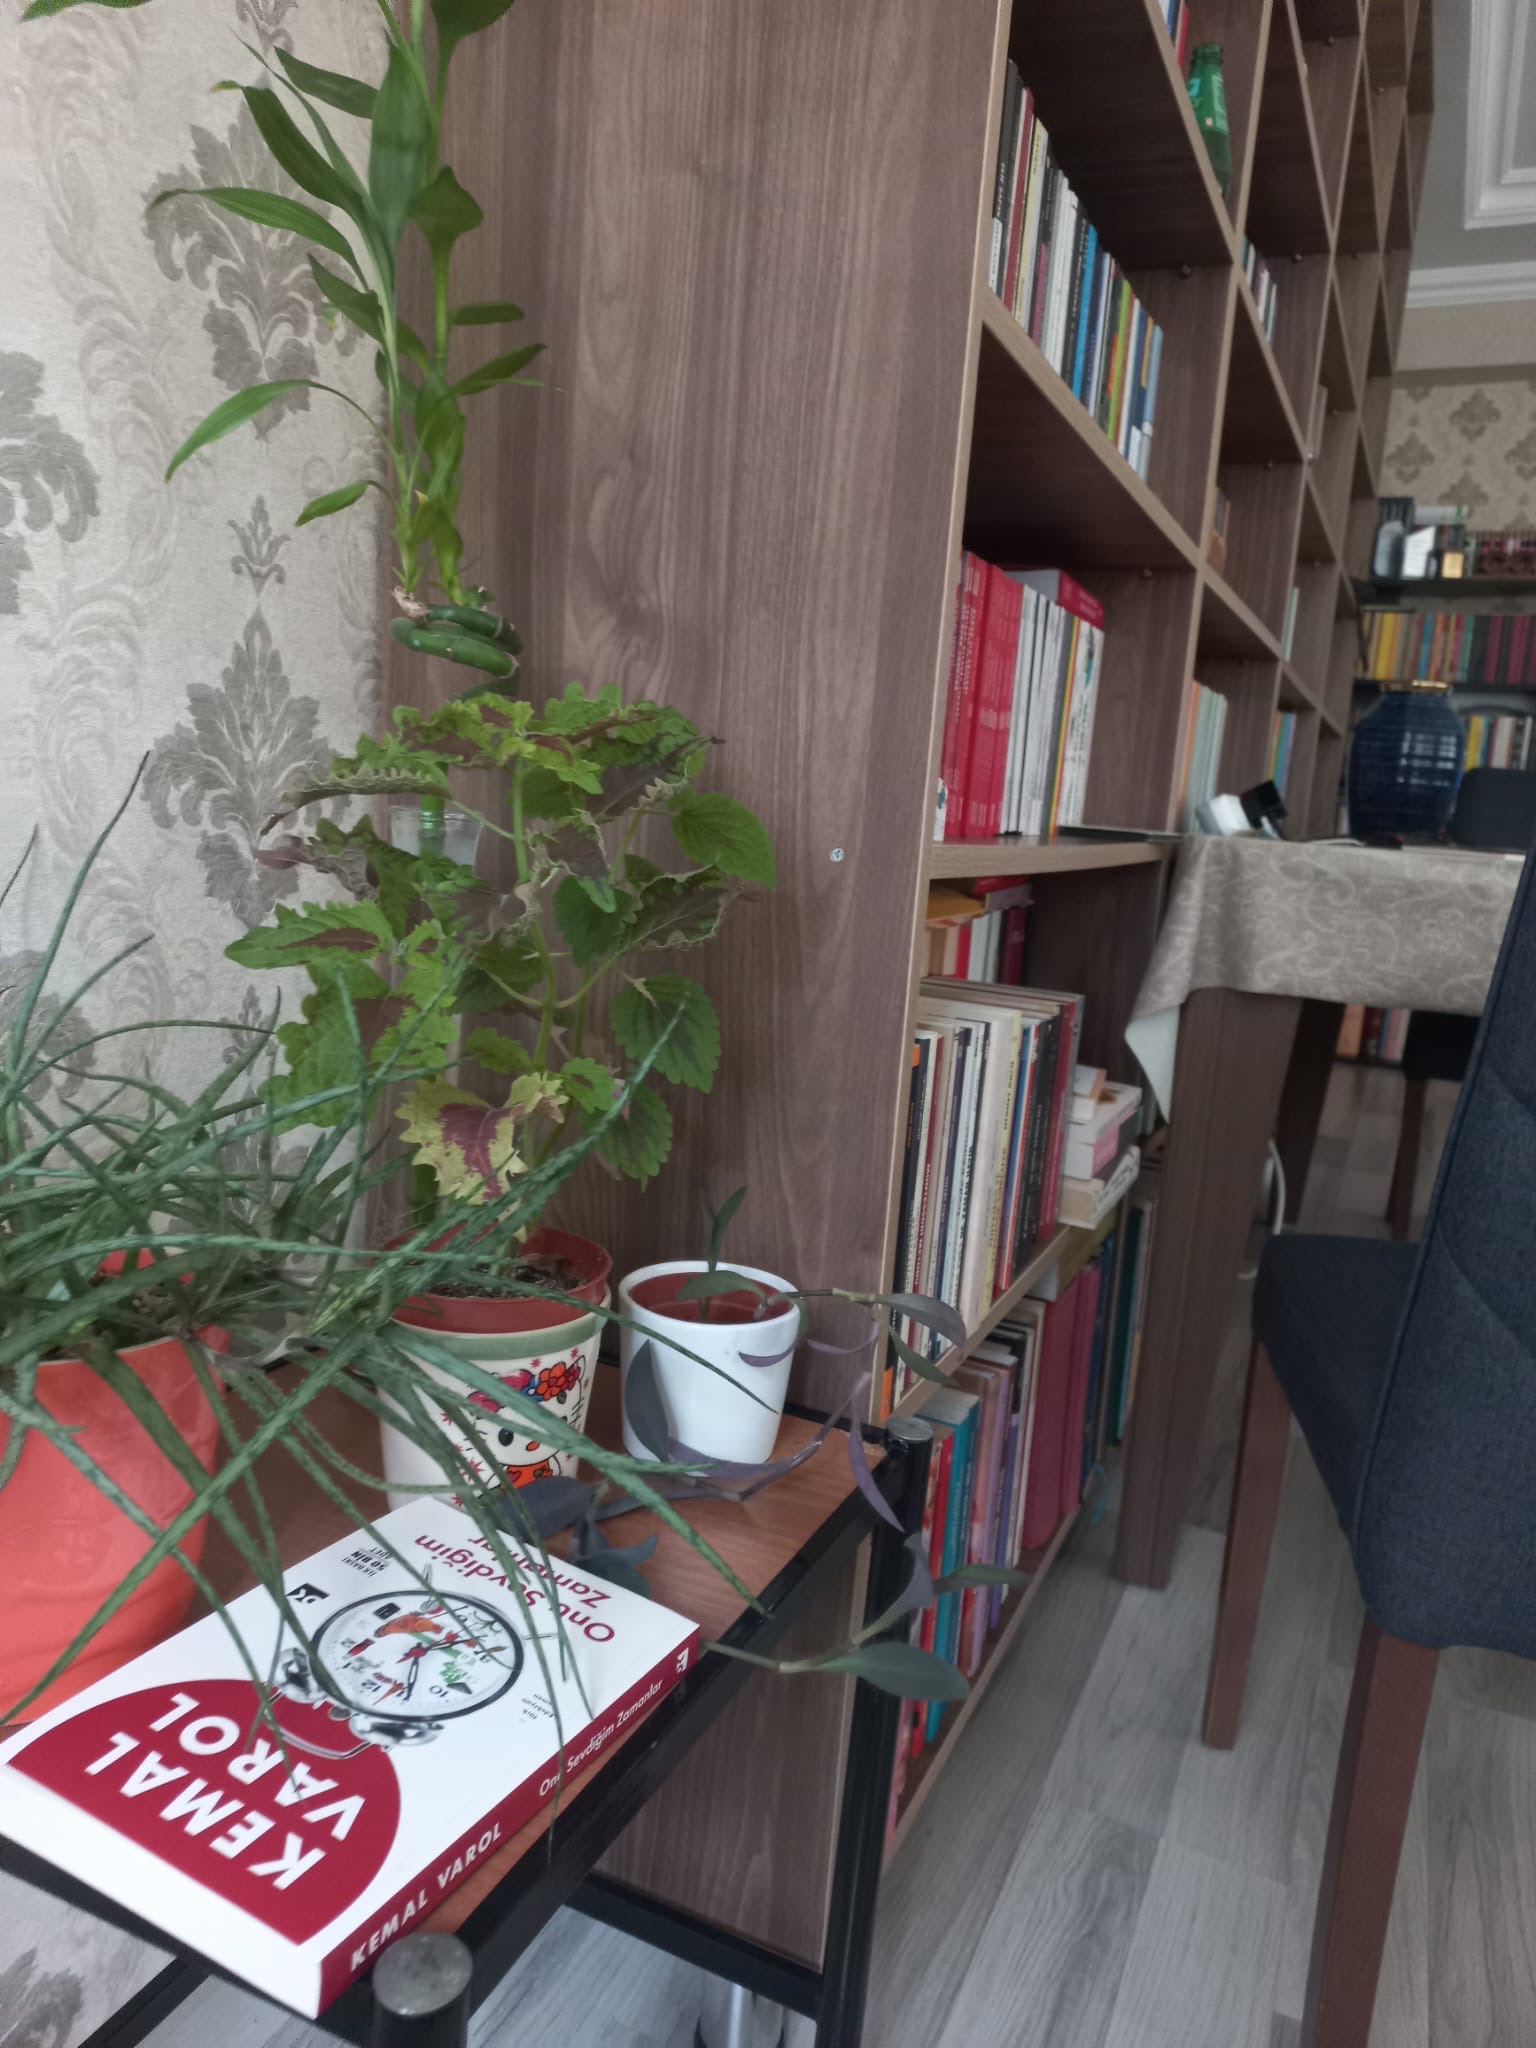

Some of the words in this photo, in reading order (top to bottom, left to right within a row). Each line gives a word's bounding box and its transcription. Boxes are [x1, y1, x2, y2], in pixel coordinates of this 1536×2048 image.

[85, 1732, 324, 1889] KEMAL
[149, 1693, 364, 1840] VAROL
[351, 1889, 427, 1970] KEMAL
[437, 1823, 500, 1888] VAROL
[566, 1724, 614, 1772] Sevdiğim
[616, 1679, 662, 1727] Zamanlar
